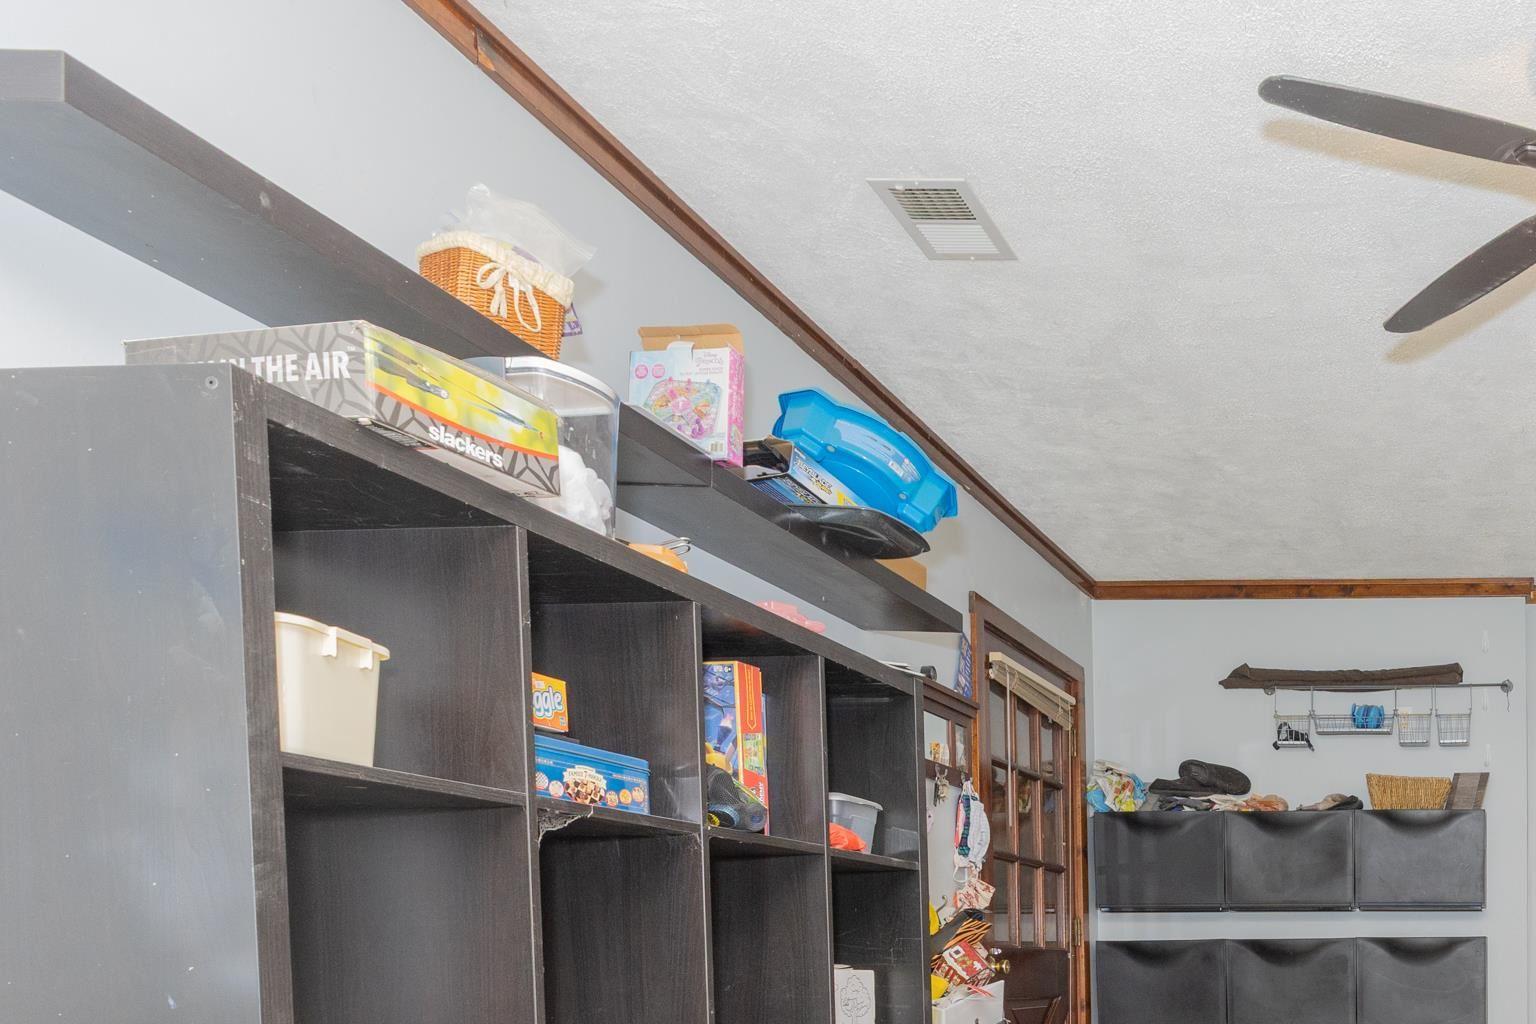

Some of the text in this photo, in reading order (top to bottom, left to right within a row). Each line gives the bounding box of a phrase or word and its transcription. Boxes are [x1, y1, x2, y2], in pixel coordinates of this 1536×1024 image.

[251, 354, 299, 383] THE
[305, 351, 351, 381] AIR
[428, 425, 503, 468] slackers
[533, 686, 563, 719] ggle
